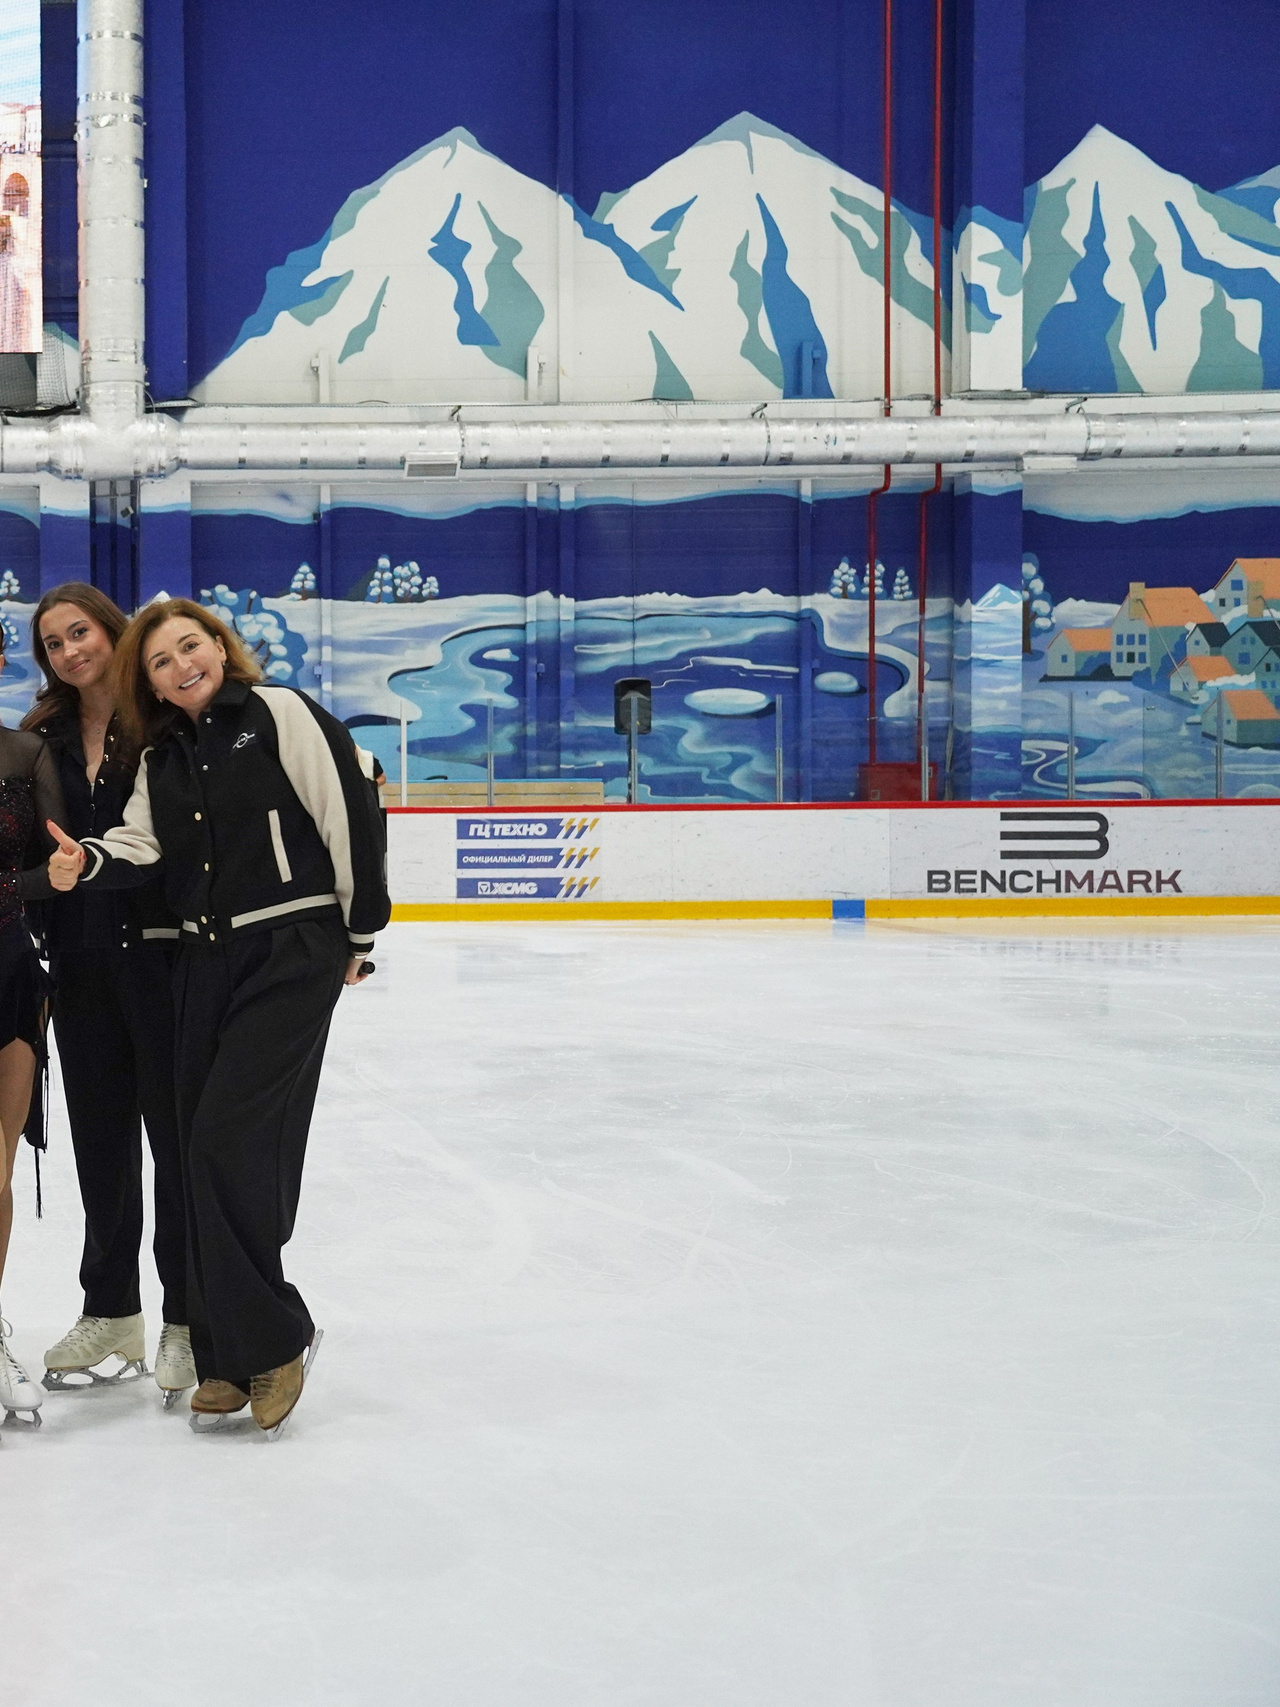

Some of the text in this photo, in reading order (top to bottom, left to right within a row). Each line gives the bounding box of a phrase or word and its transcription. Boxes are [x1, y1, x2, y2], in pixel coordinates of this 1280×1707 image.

[469, 823, 548, 839] ГЦ ТЕХНО
[462, 854, 554, 864] ОФИЦИАЛЬНЫЙ ДИЛЕР
[491, 882, 538, 895] XCMG
[927, 869, 1182, 894] BENCHMARK
